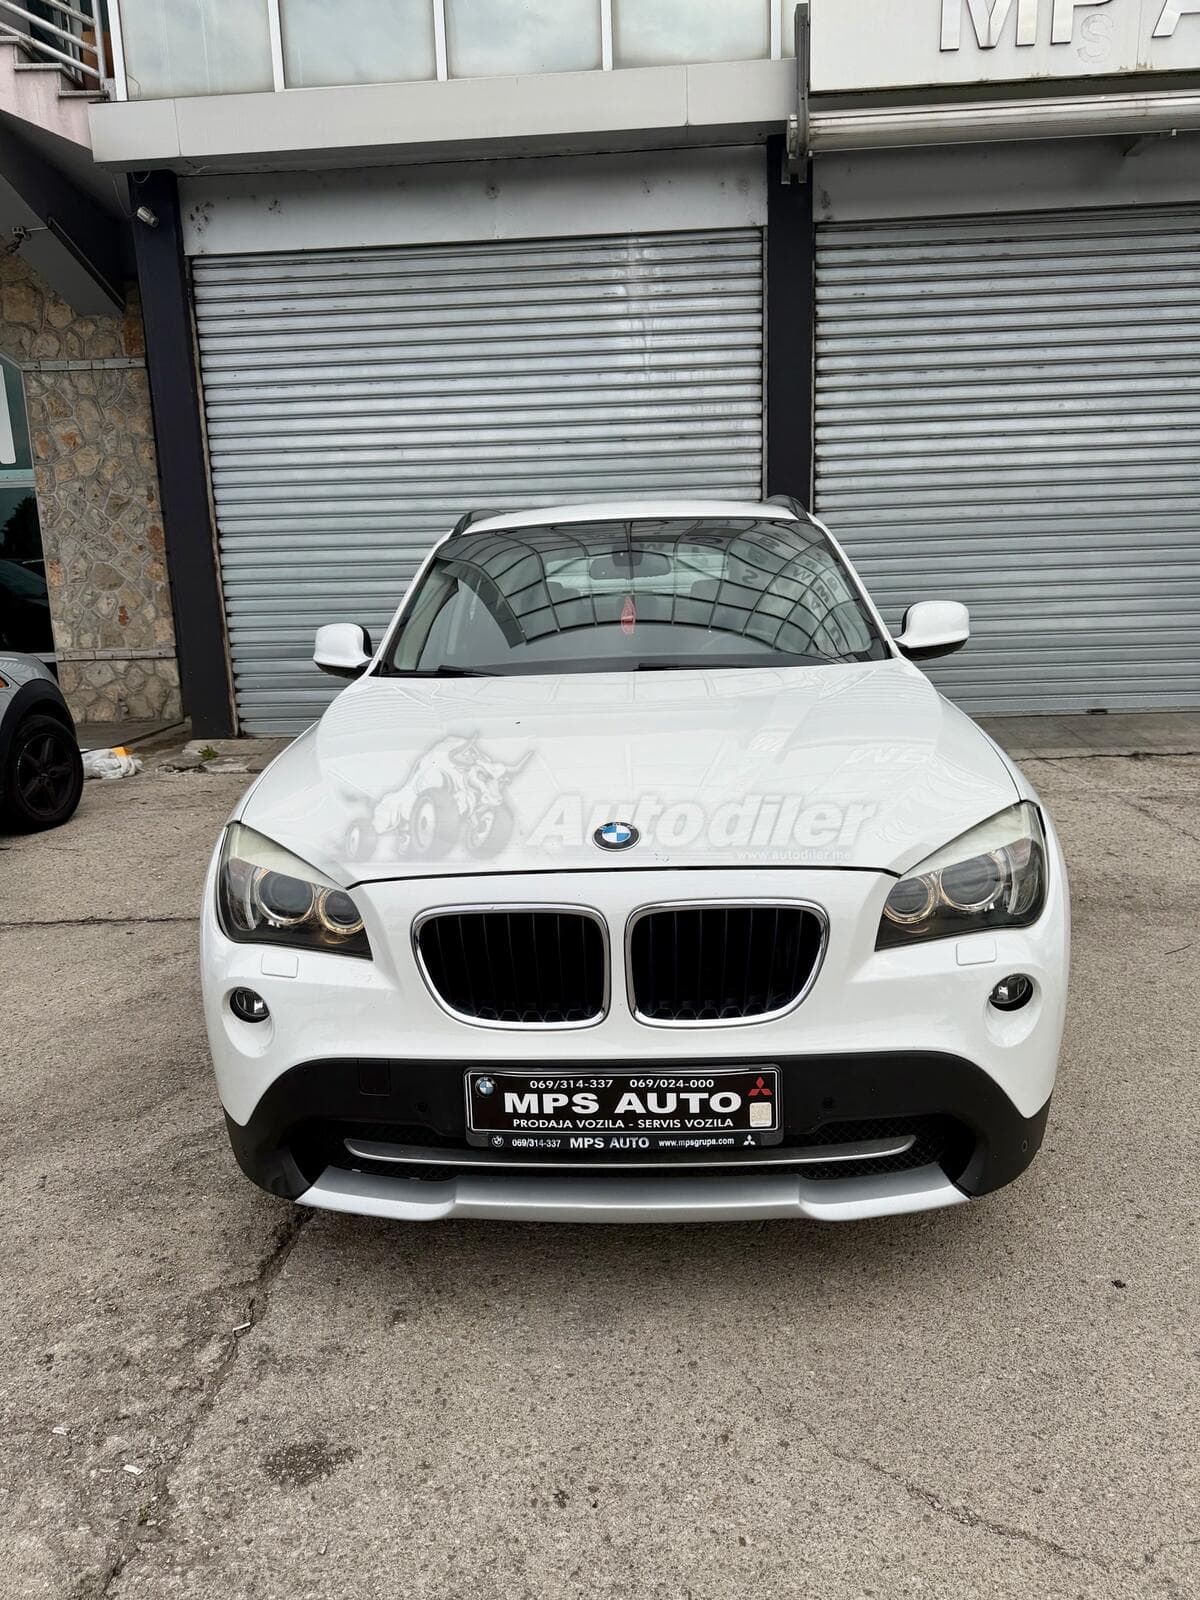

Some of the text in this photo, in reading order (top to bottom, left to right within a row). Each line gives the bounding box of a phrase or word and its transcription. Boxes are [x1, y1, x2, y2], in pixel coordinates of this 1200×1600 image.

[529, 1079, 715, 1090] 069/314-337 069/024-000
[503, 1091, 742, 1115] MPS AUTO
[512, 1119, 573, 1129] PRODAJA
[576, 1119, 625, 1129] VOZILA
[637, 1119, 681, 1129] SERVIS
[684, 1118, 734, 1128] VOZILA
[511, 1136, 735, 1149] 069/314-337 MPS AUTO www.mpsgrupa.com
